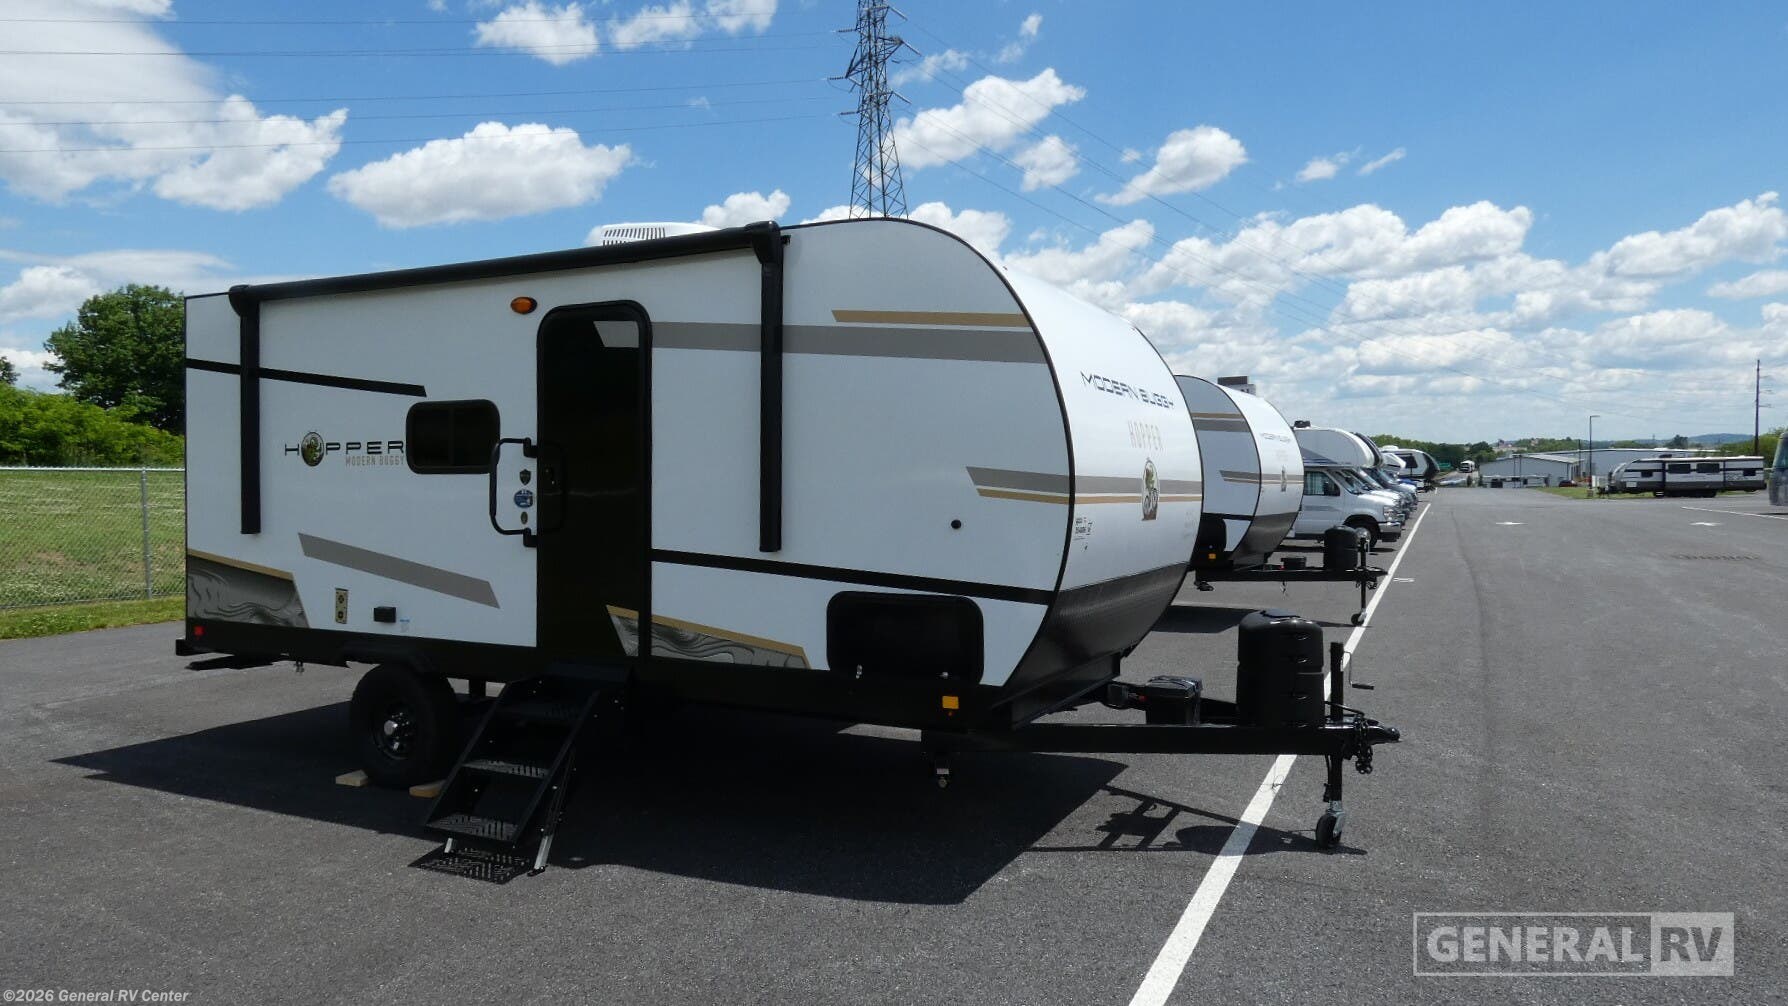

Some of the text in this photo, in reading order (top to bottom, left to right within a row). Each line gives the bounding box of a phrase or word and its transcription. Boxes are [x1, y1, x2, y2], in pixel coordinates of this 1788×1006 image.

[1080, 371, 1138, 399] MODERN
[1128, 419, 1164, 451] HOPPER
[345, 456, 405, 467] MODERN BUGGY
